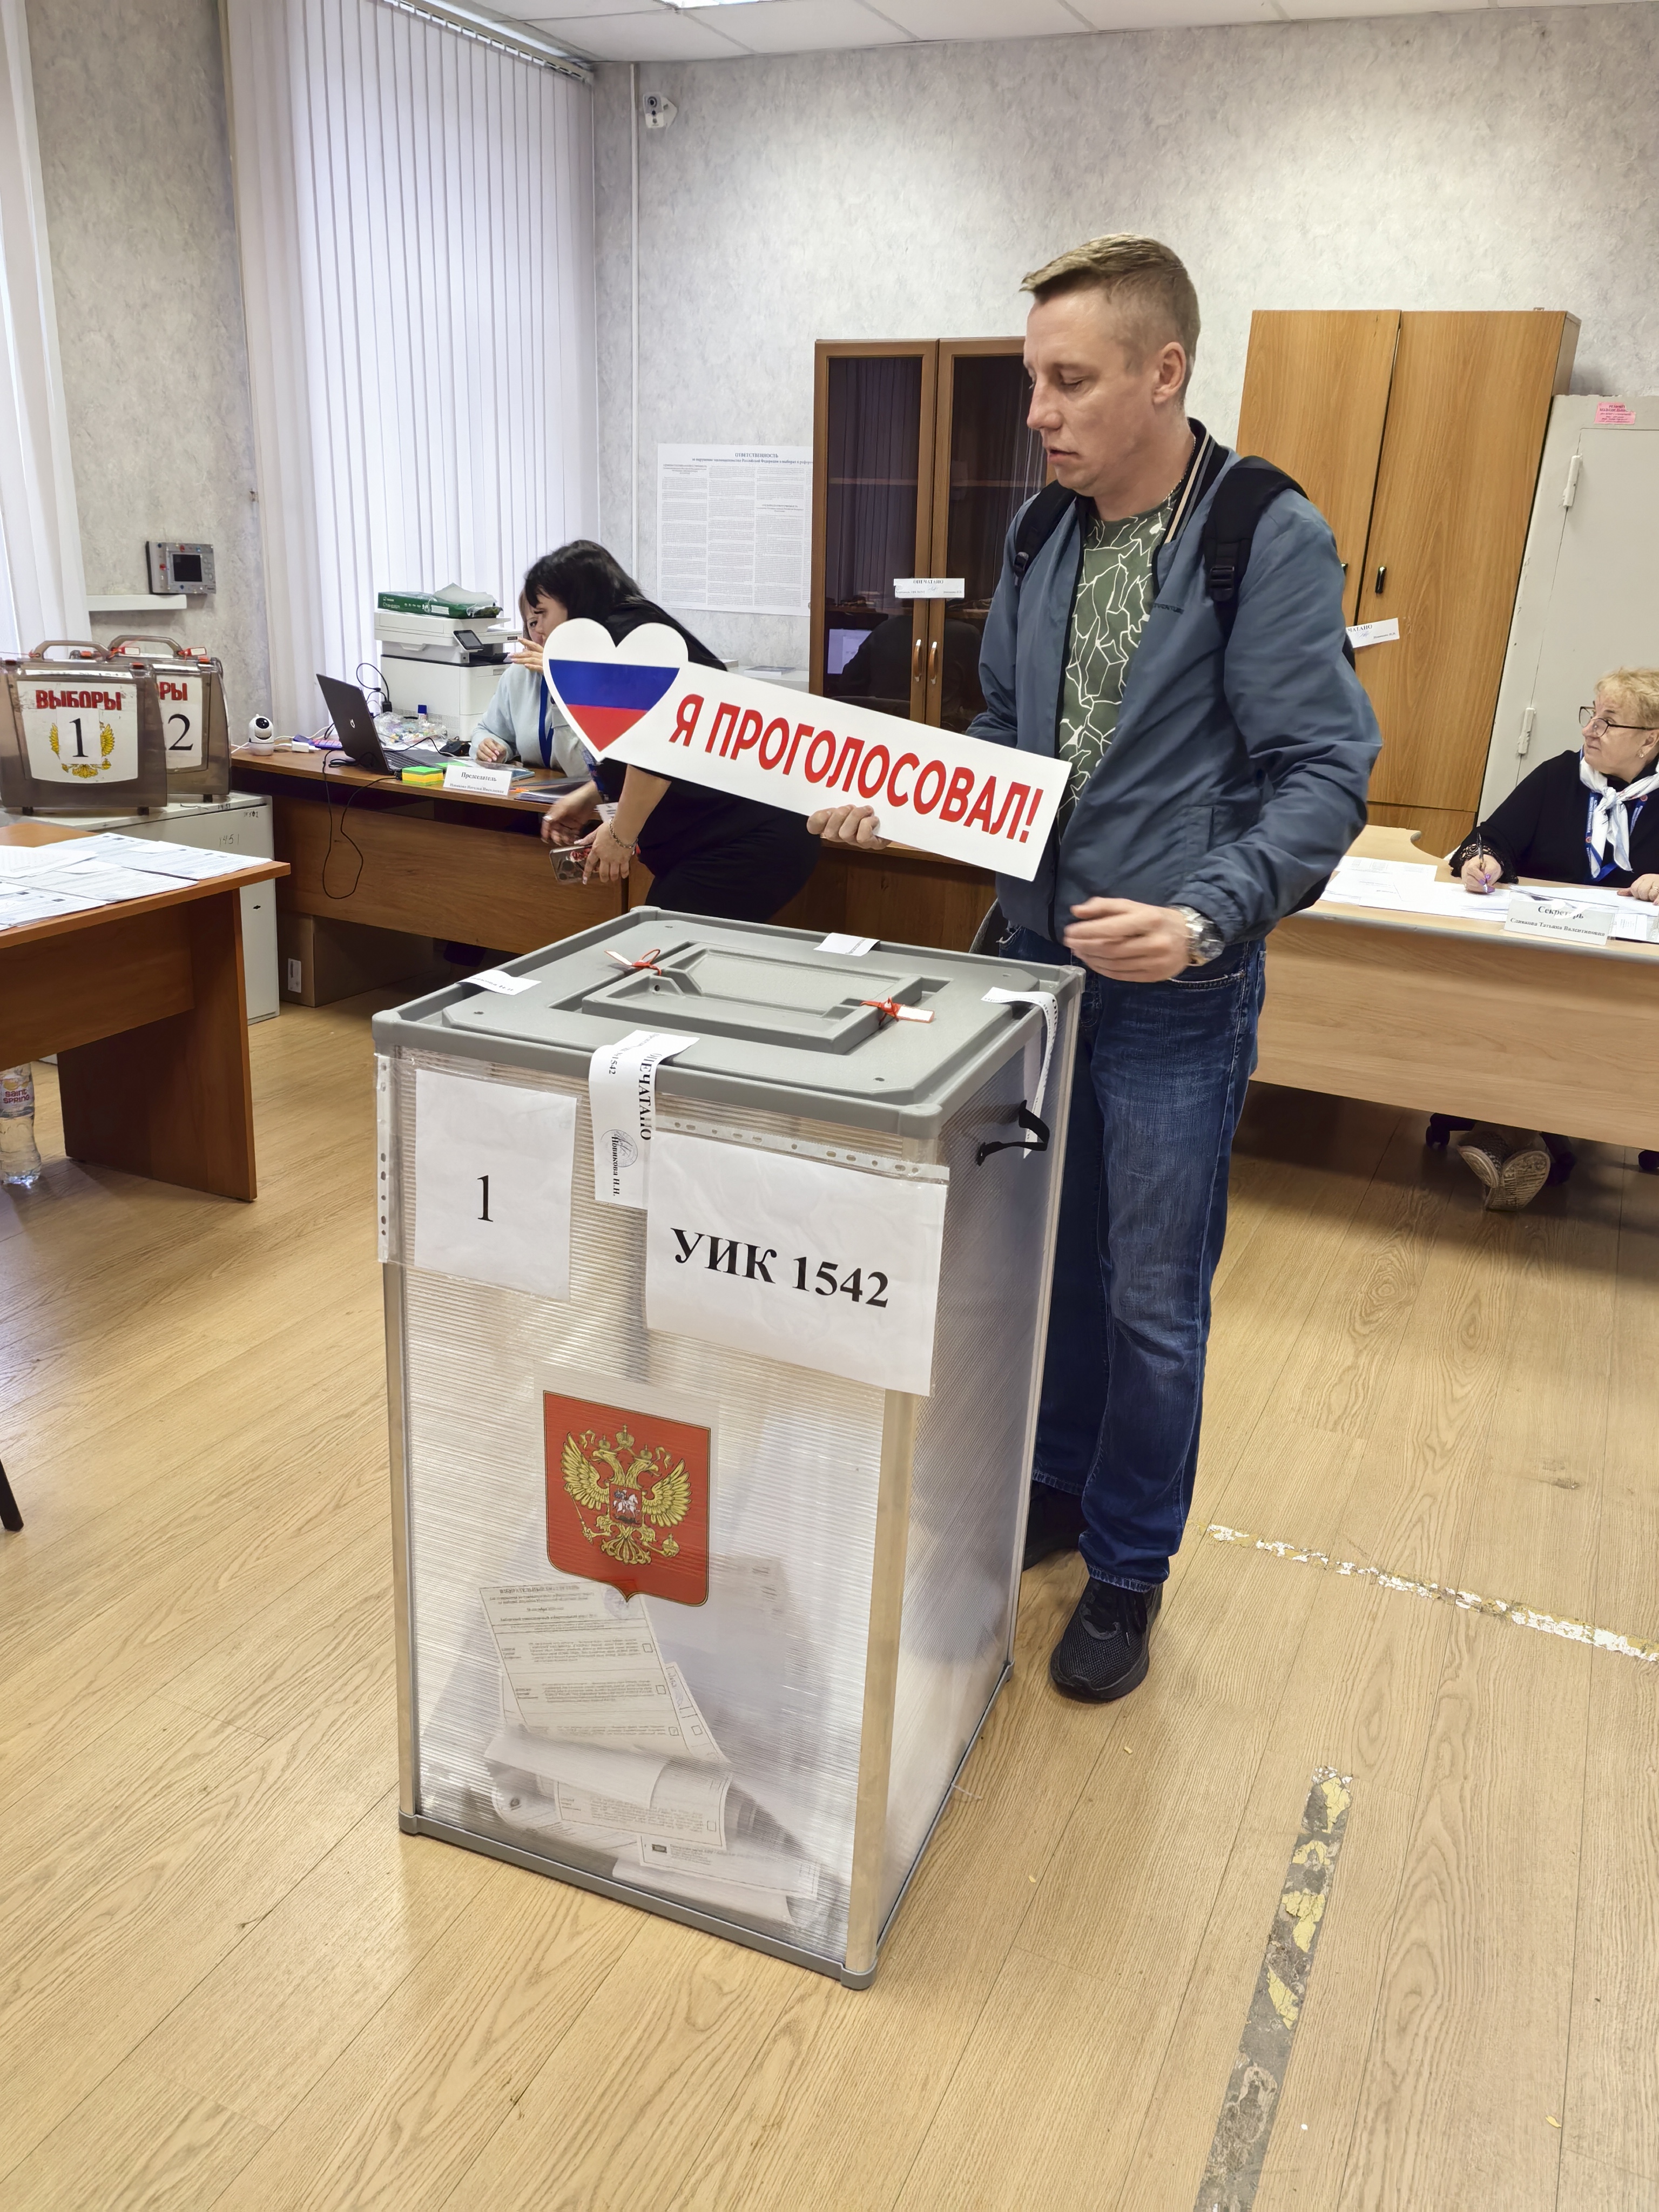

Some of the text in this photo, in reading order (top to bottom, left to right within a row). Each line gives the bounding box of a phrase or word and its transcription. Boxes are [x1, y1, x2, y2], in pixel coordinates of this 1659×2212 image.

[1348, 624, 1373, 632] ЧАТАНО
[35, 689, 122, 711] ВЫБОРЫ
[69, 718, 89, 758] 1
[167, 713, 194, 751] 2
[461, 772, 497, 782] Председатель
[669, 694, 1044, 844] Я ПРОГОЛОСОВАЛ!
[1538, 906, 1584, 920] Секретрь
[1539, 921, 1562, 930] Татьяна
[1563, 926, 1606, 937] Валентиновна
[611, 1136, 620, 1177] Новикова
[477, 1175, 494, 1223] 1
[670, 1227, 889, 1308] УИК 1542
